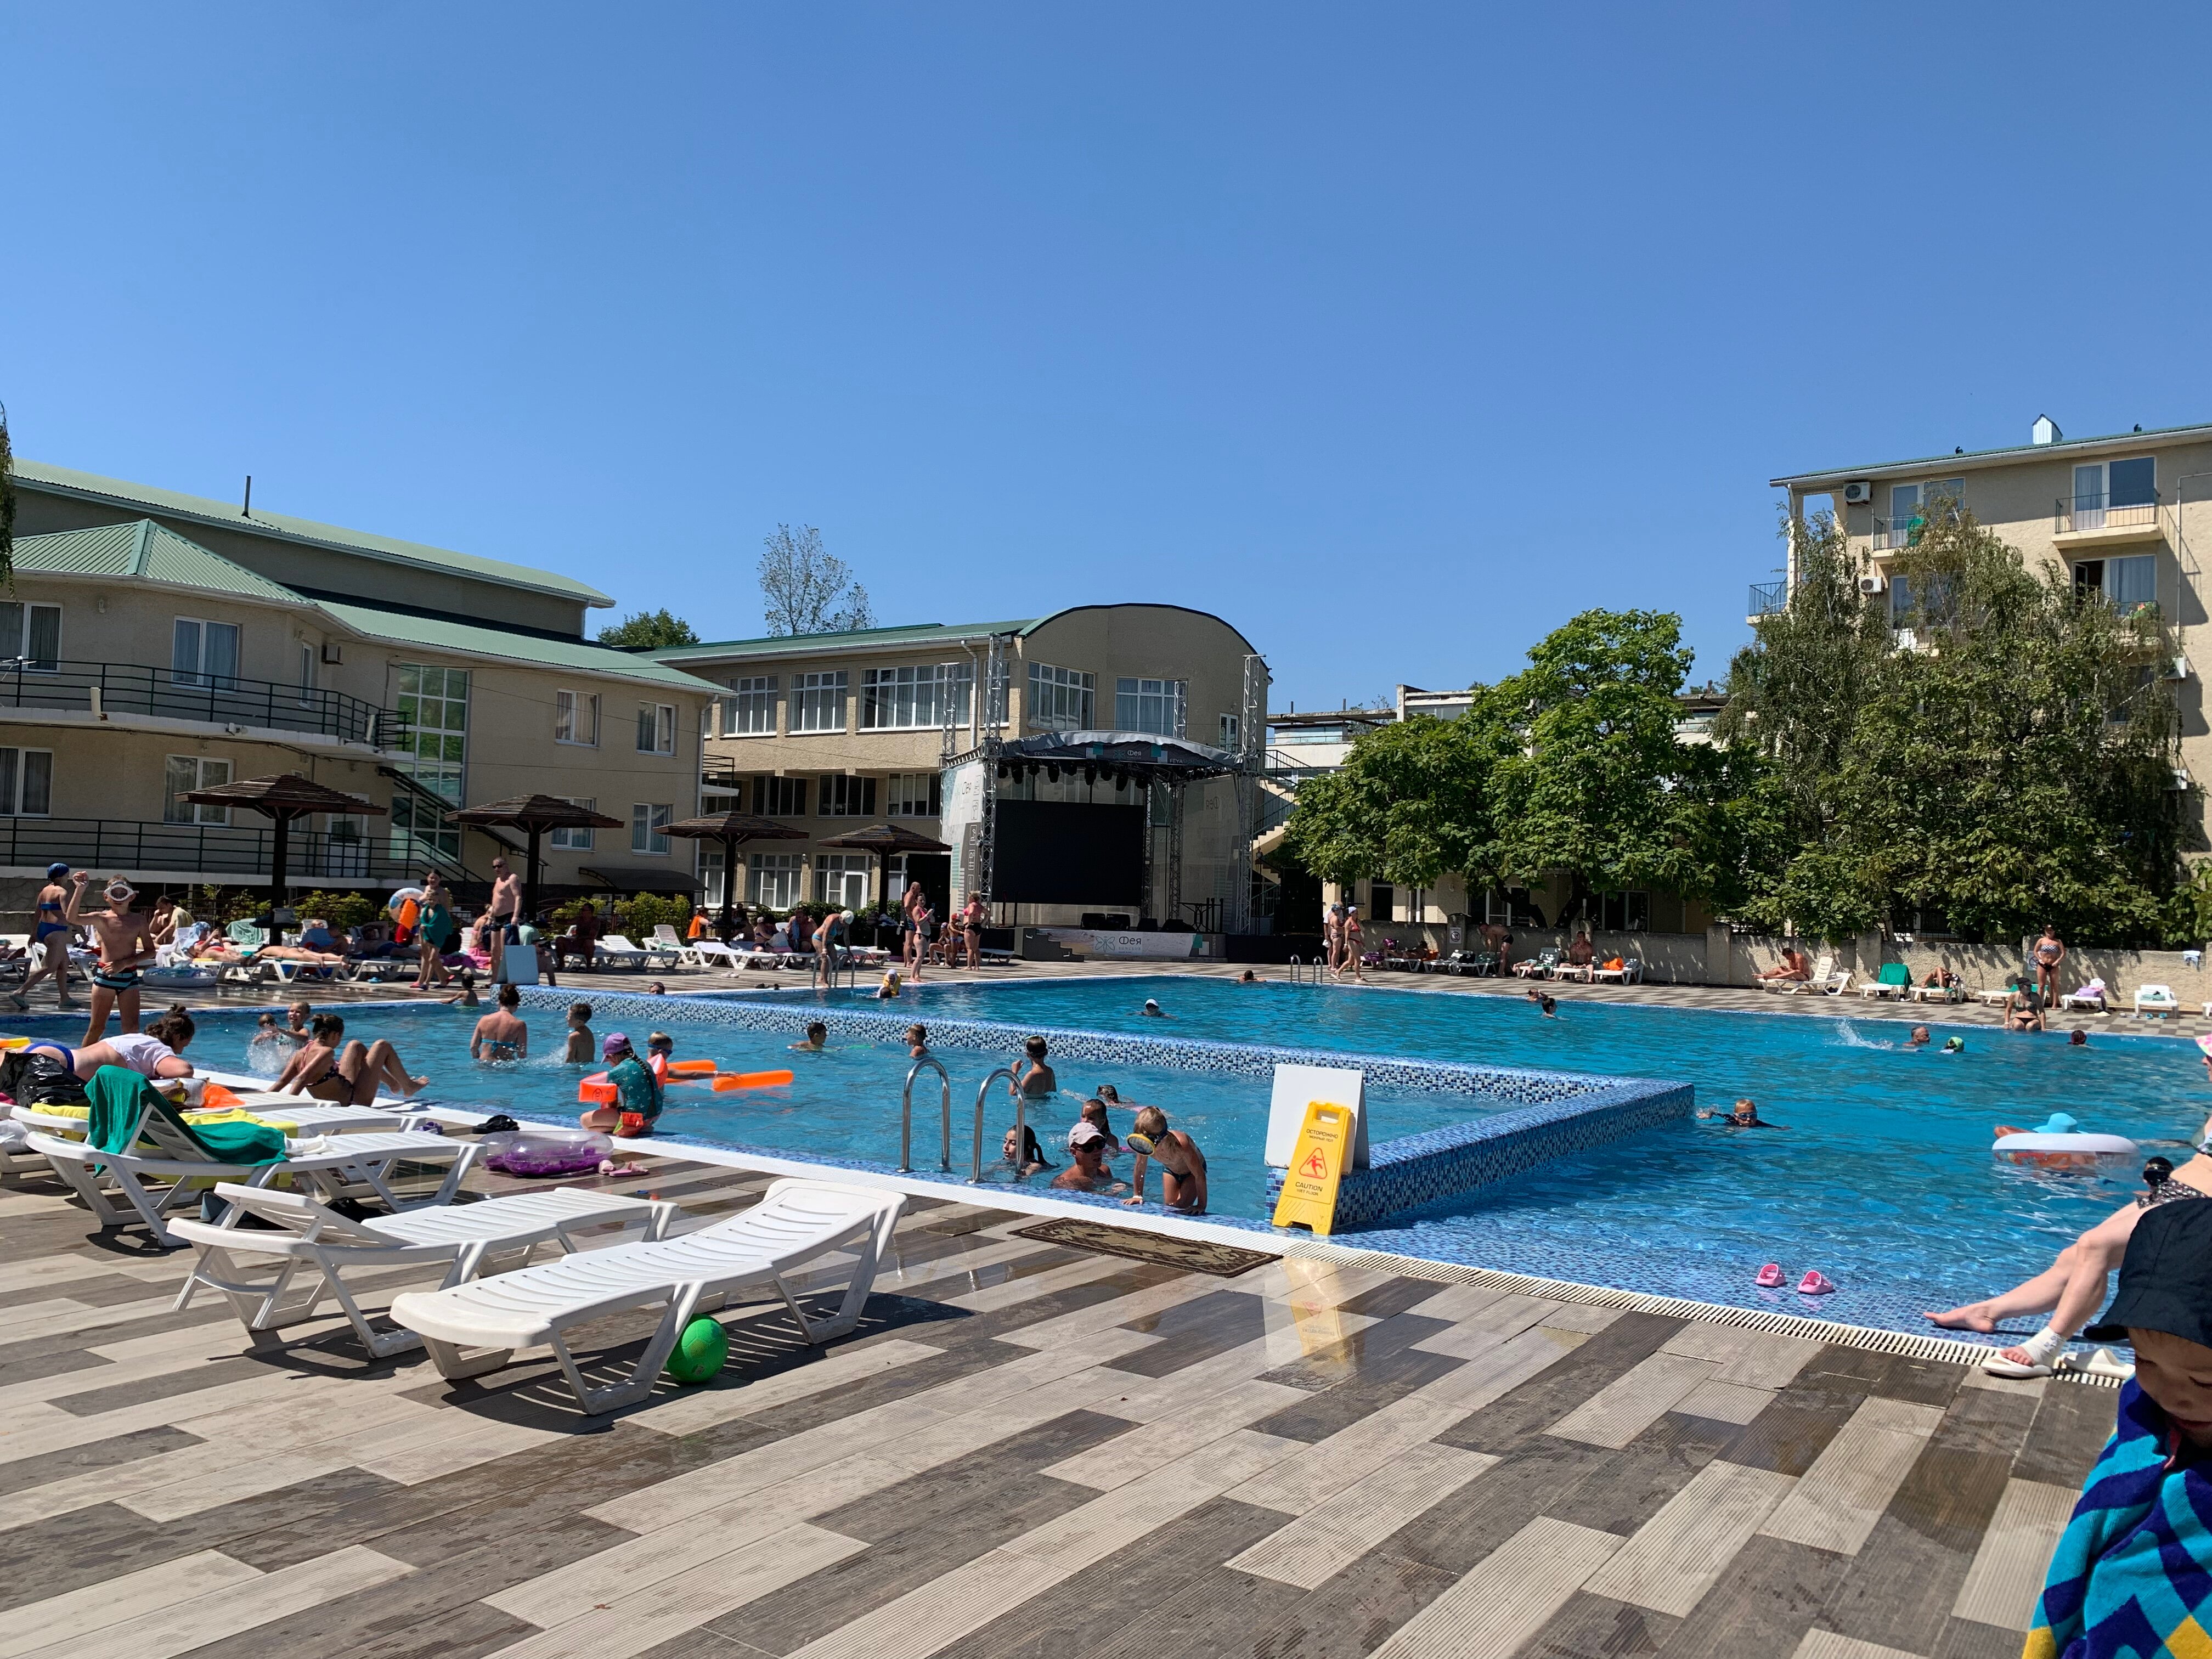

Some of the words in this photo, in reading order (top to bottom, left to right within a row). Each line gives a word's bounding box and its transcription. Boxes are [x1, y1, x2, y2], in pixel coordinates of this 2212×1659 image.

[1119, 936, 1141, 945] Фея
[1306, 1128, 1339, 1139] ОСТОРОЖНО
[1295, 1181, 1323, 1192] CAUTION
